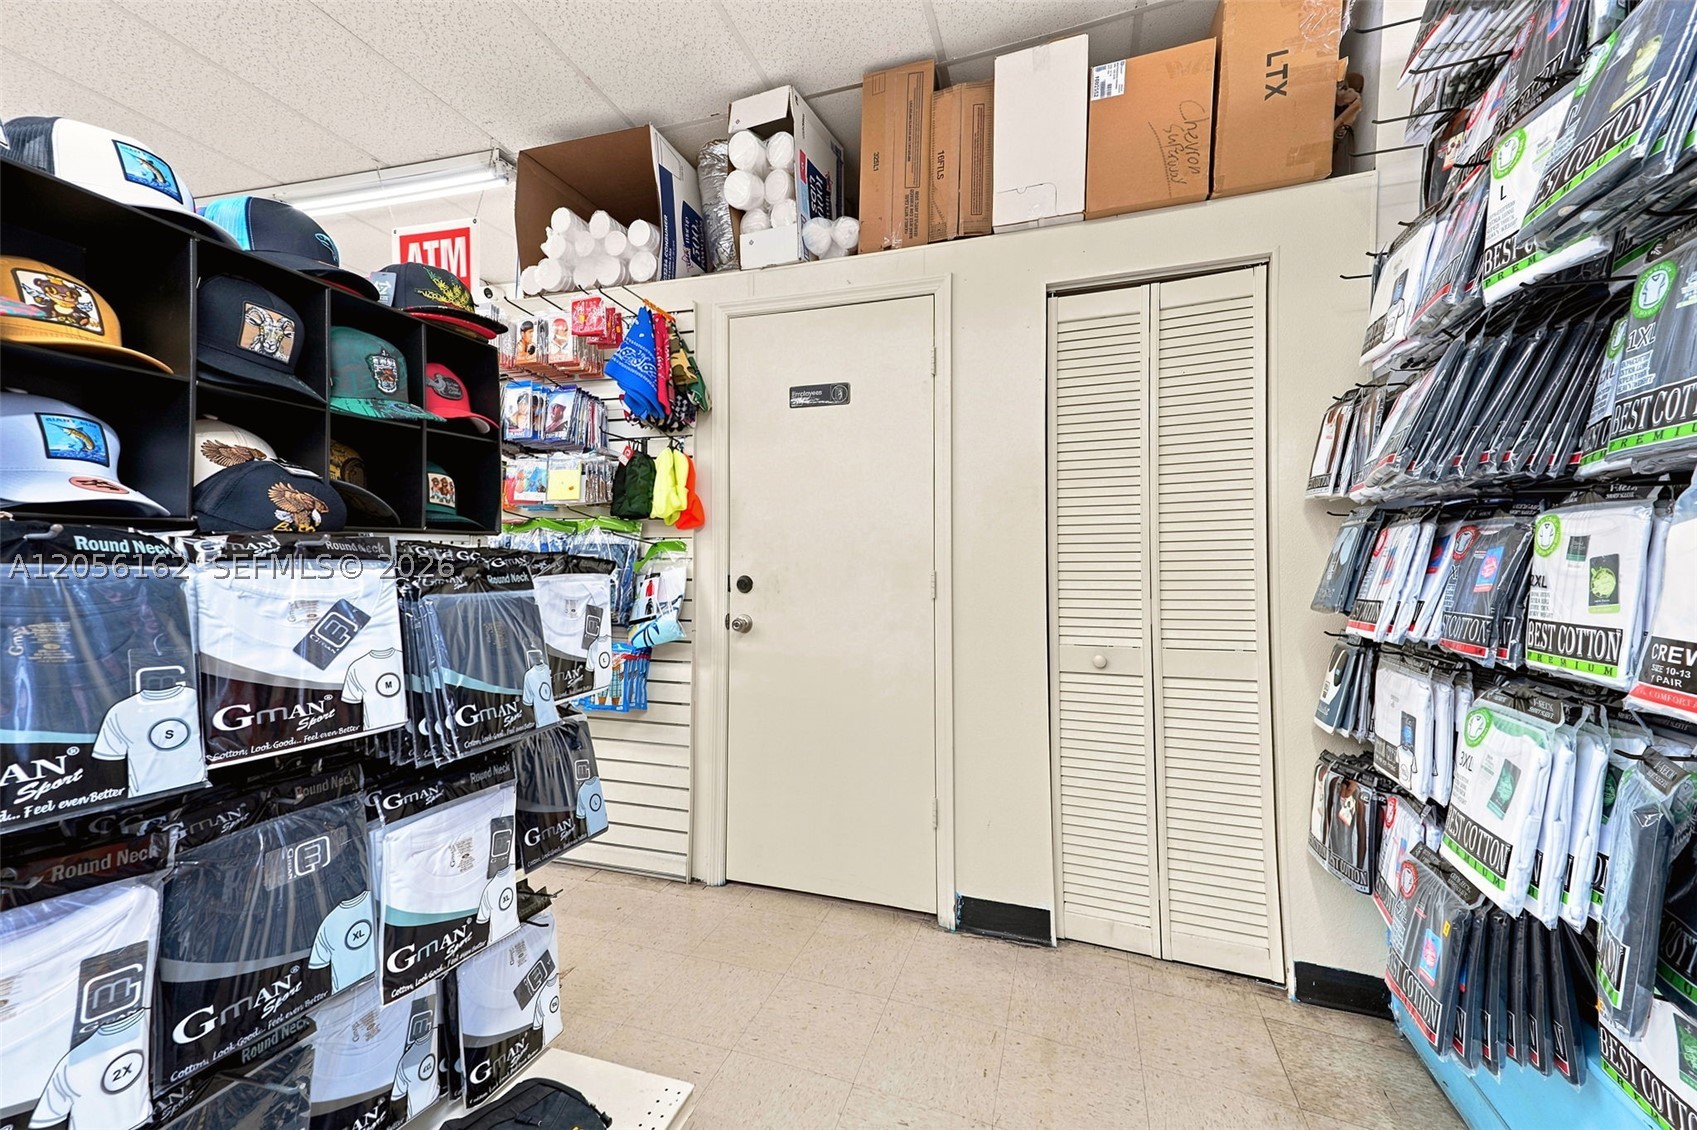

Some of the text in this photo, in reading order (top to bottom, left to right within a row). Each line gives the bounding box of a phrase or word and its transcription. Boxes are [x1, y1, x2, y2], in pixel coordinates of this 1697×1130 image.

[1264, 50, 1289, 101] LTX
[1179, 99, 1210, 174] Chevron
[1564, 90, 1656, 180] COTTON
[809, 174, 818, 214] LIDS
[1500, 184, 1506, 201] L
[407, 236, 467, 279] ATM
[1483, 233, 1518, 275] BEST
[1611, 395, 1654, 435] BEST
[73, 535, 174, 555] Round Neck
[325, 540, 358, 553] Round
[486, 572, 529, 585] Round Neck
[1527, 620, 1621, 663] BEST COTTON
[1527, 652, 1615, 678] PREMIUM
[1665, 666, 1692, 679] 10-13
[384, 681, 393, 689] M
[1656, 675, 1682, 688] PAIR
[165, 729, 174, 740] S
[296, 708, 337, 732] Sport
[250, 742, 272, 754] Look
[303, 731, 319, 743] Feel
[318, 731, 338, 740] even
[338, 725, 361, 736] Better
[1459, 751, 1473, 773] 3XL
[13, 768, 84, 804] Sport
[24, 800, 56, 819] Feel
[58, 794, 88, 810] even
[87, 787, 126, 802] Better
[1464, 819, 1512, 875] COTTON
[51, 853, 112, 883] Round
[351, 929, 366, 942] XL
[260, 980, 303, 1020] Sport
[1402, 969, 1439, 1030] COTTON
[212, 1043, 236, 1062] Look
[267, 1014, 284, 1029] Feel
[283, 1004, 304, 1020] even
[304, 990, 329, 1009] Better
[1600, 1026, 1638, 1087] BEST
[112, 1062, 133, 1083] 2X
